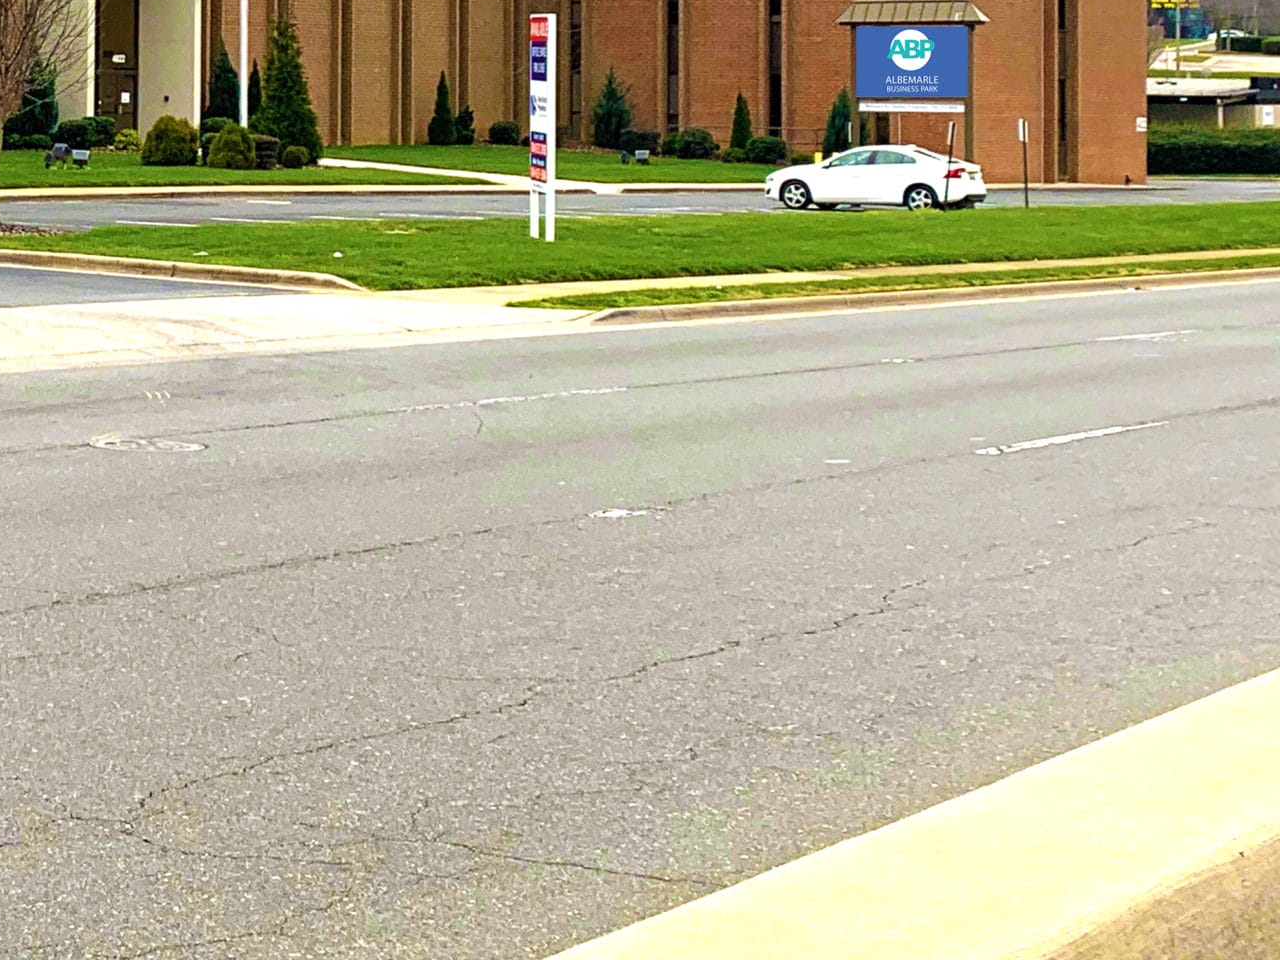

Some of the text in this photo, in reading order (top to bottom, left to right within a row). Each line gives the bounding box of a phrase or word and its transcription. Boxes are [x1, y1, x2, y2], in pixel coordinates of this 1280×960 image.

[887, 39, 936, 59] ABP
[885, 75, 939, 84] ALBEMARLE
[886, 85, 938, 93] BUSINESS PARK
